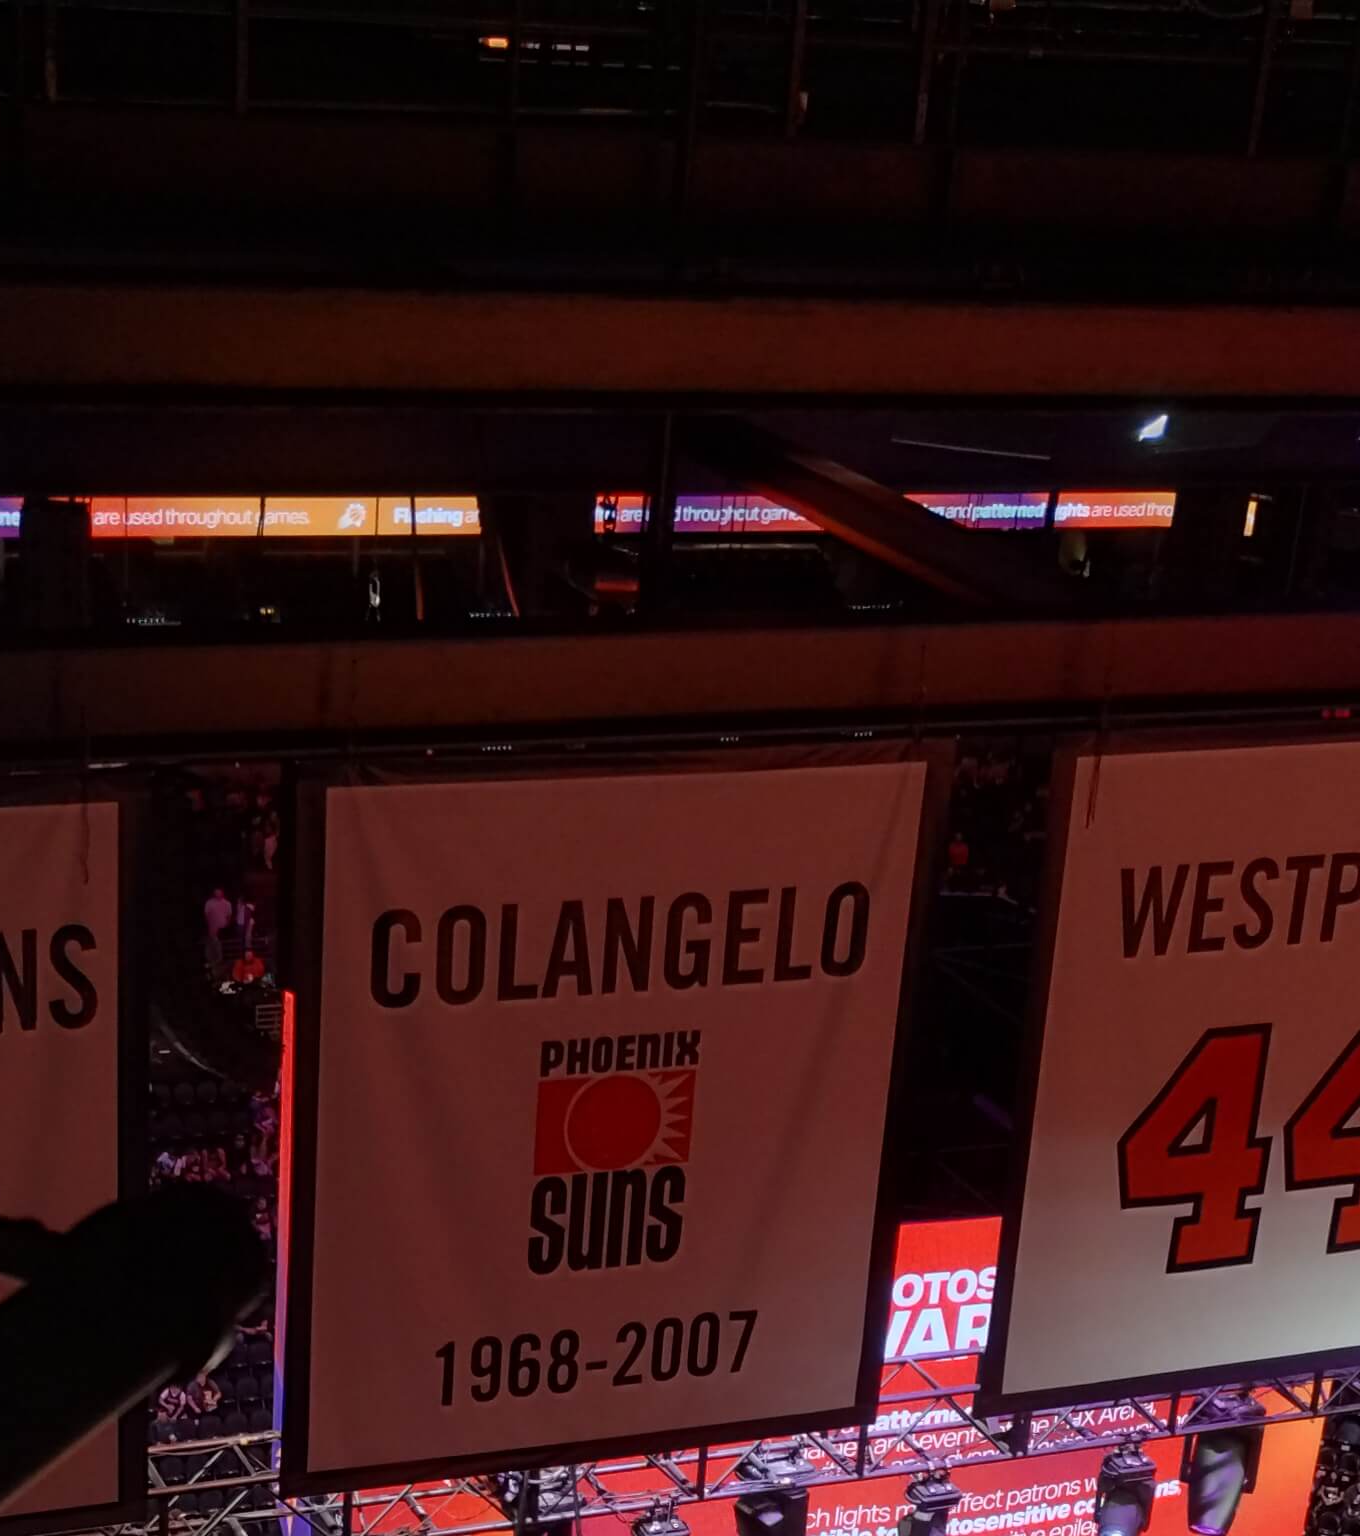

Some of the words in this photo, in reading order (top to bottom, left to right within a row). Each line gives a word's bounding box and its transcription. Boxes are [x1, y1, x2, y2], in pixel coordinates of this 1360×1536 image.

[94, 510, 123, 526] are
[125, 508, 163, 526] used
[165, 508, 253, 529] throughout
[1091, 505, 1112, 518] are
[1113, 503, 1145, 518] used
[370, 880, 871, 1008] COLANGELO
[540, 1029, 701, 1078] PHOENIX
[434, 1309, 758, 1406] 1968-2007
[1006, 1478, 1081, 1512] patrons
[834, 1503, 892, 1530] lights
